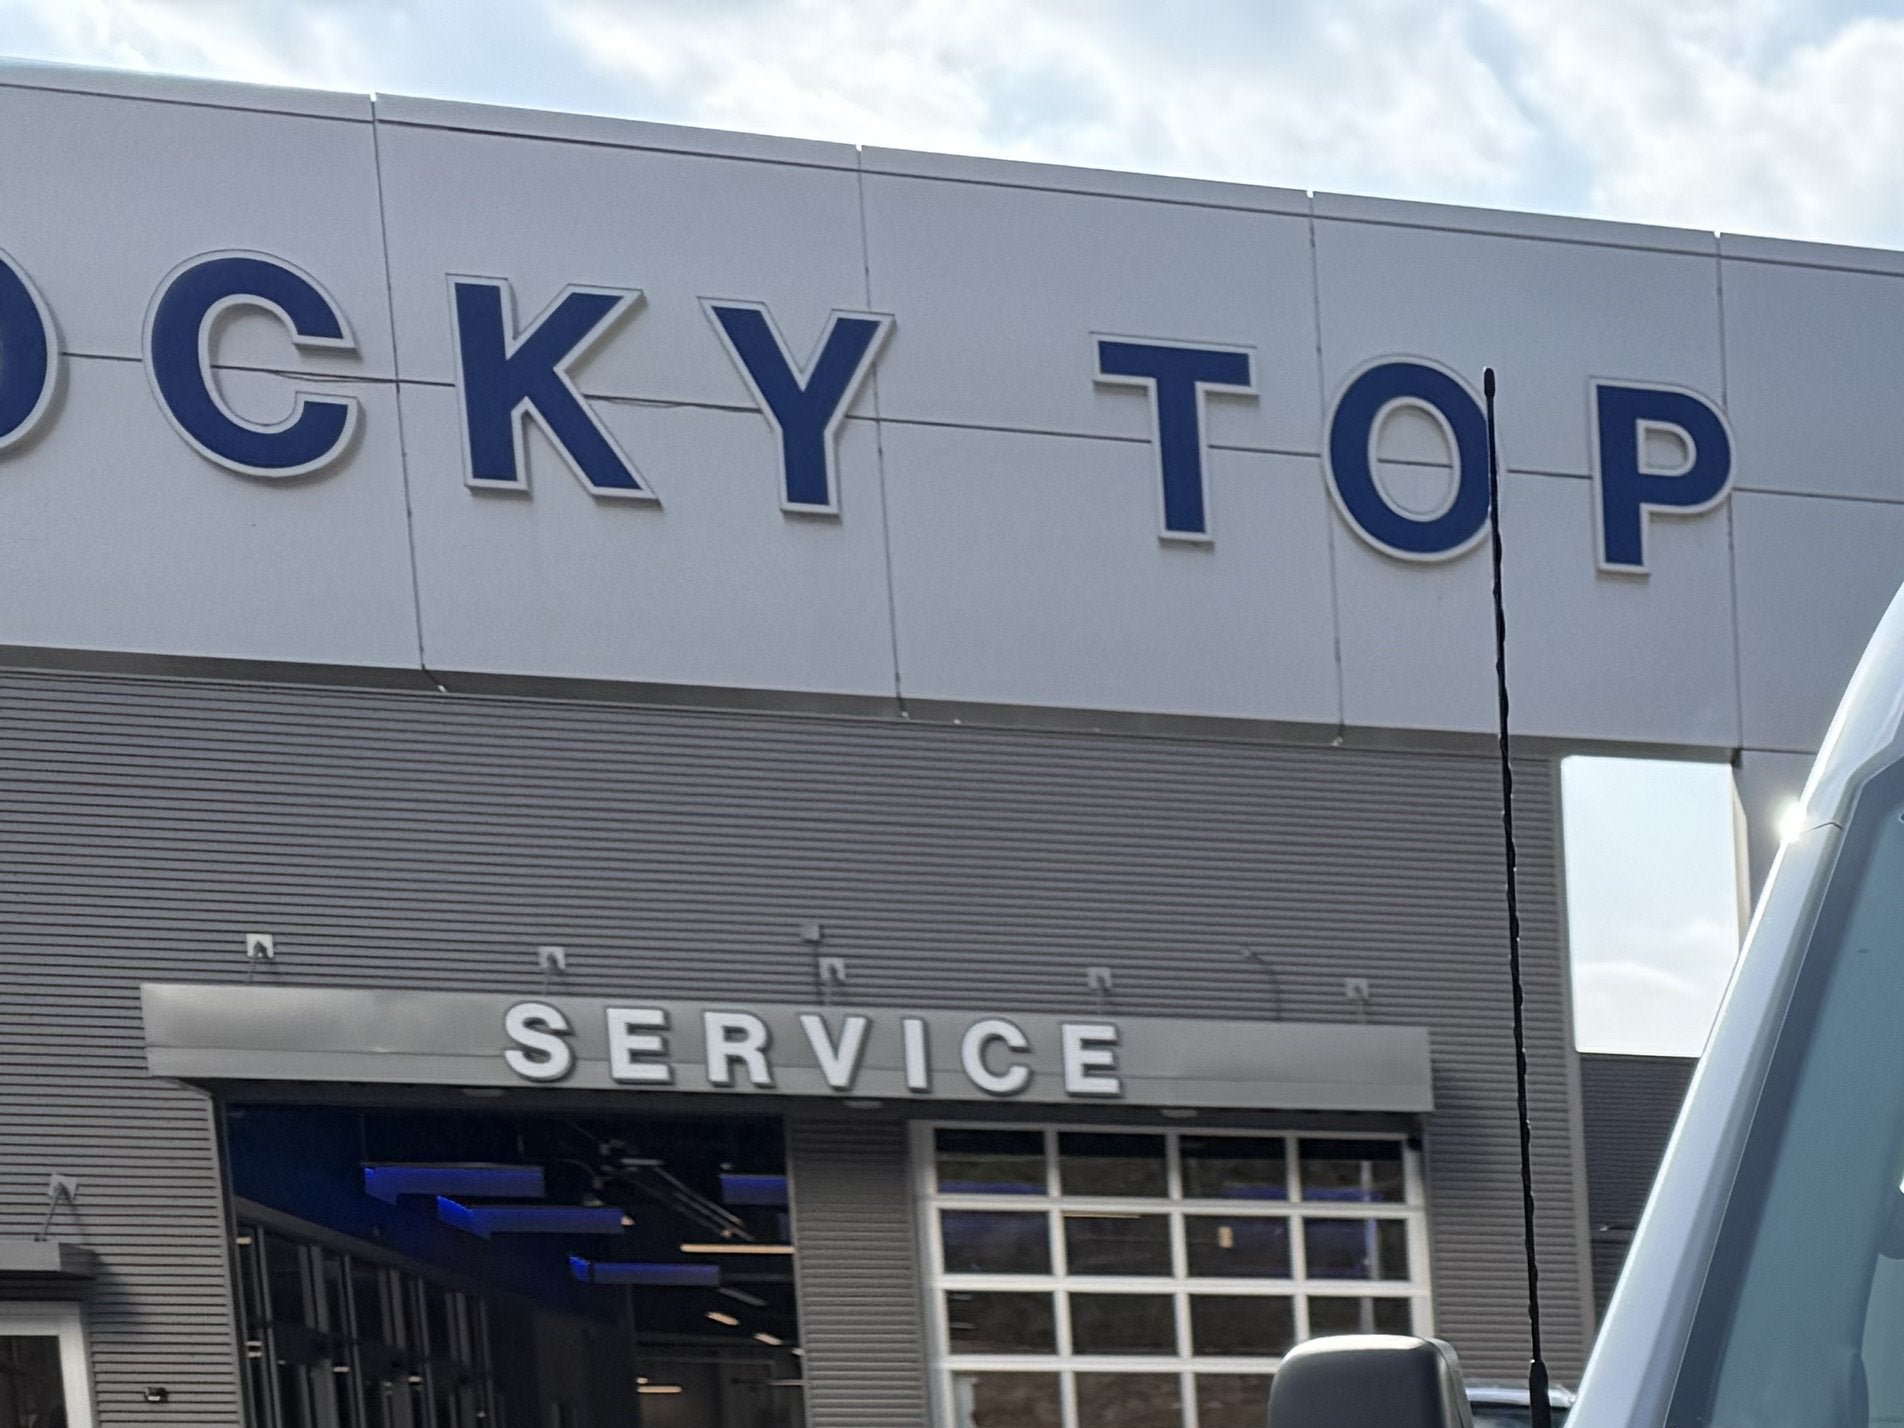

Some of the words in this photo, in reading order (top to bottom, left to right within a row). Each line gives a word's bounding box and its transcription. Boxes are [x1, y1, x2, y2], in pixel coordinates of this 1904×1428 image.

[0, 248, 895, 515] CKY
[1090, 332, 1734, 576] TOP
[504, 1002, 1122, 1096] SERVICE
